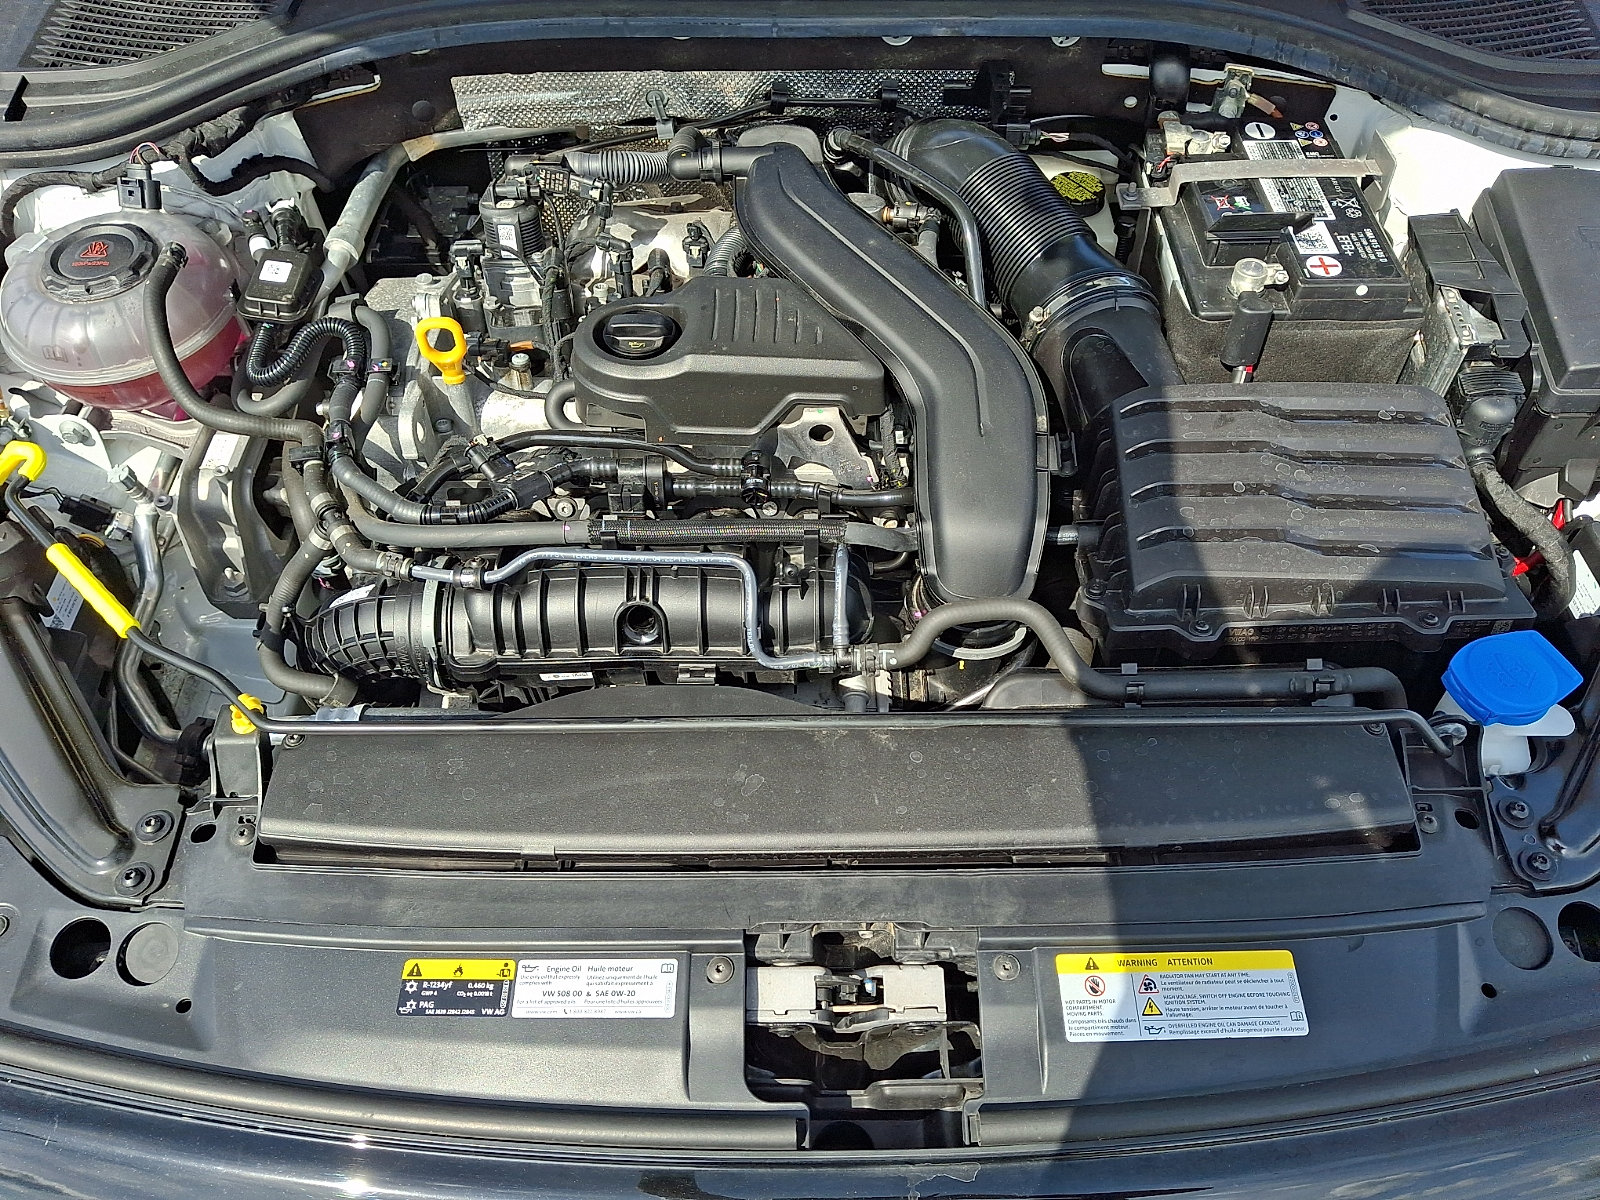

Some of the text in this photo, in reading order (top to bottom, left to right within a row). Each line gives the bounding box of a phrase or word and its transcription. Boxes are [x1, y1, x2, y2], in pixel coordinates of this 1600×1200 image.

[1336, 235, 1355, 256] EFB+
[1168, 958, 1213, 966] ATTENTION
[547, 965, 570, 974] Engine
[422, 981, 453, 990] R-1234yf
[486, 982, 494, 990] kg
